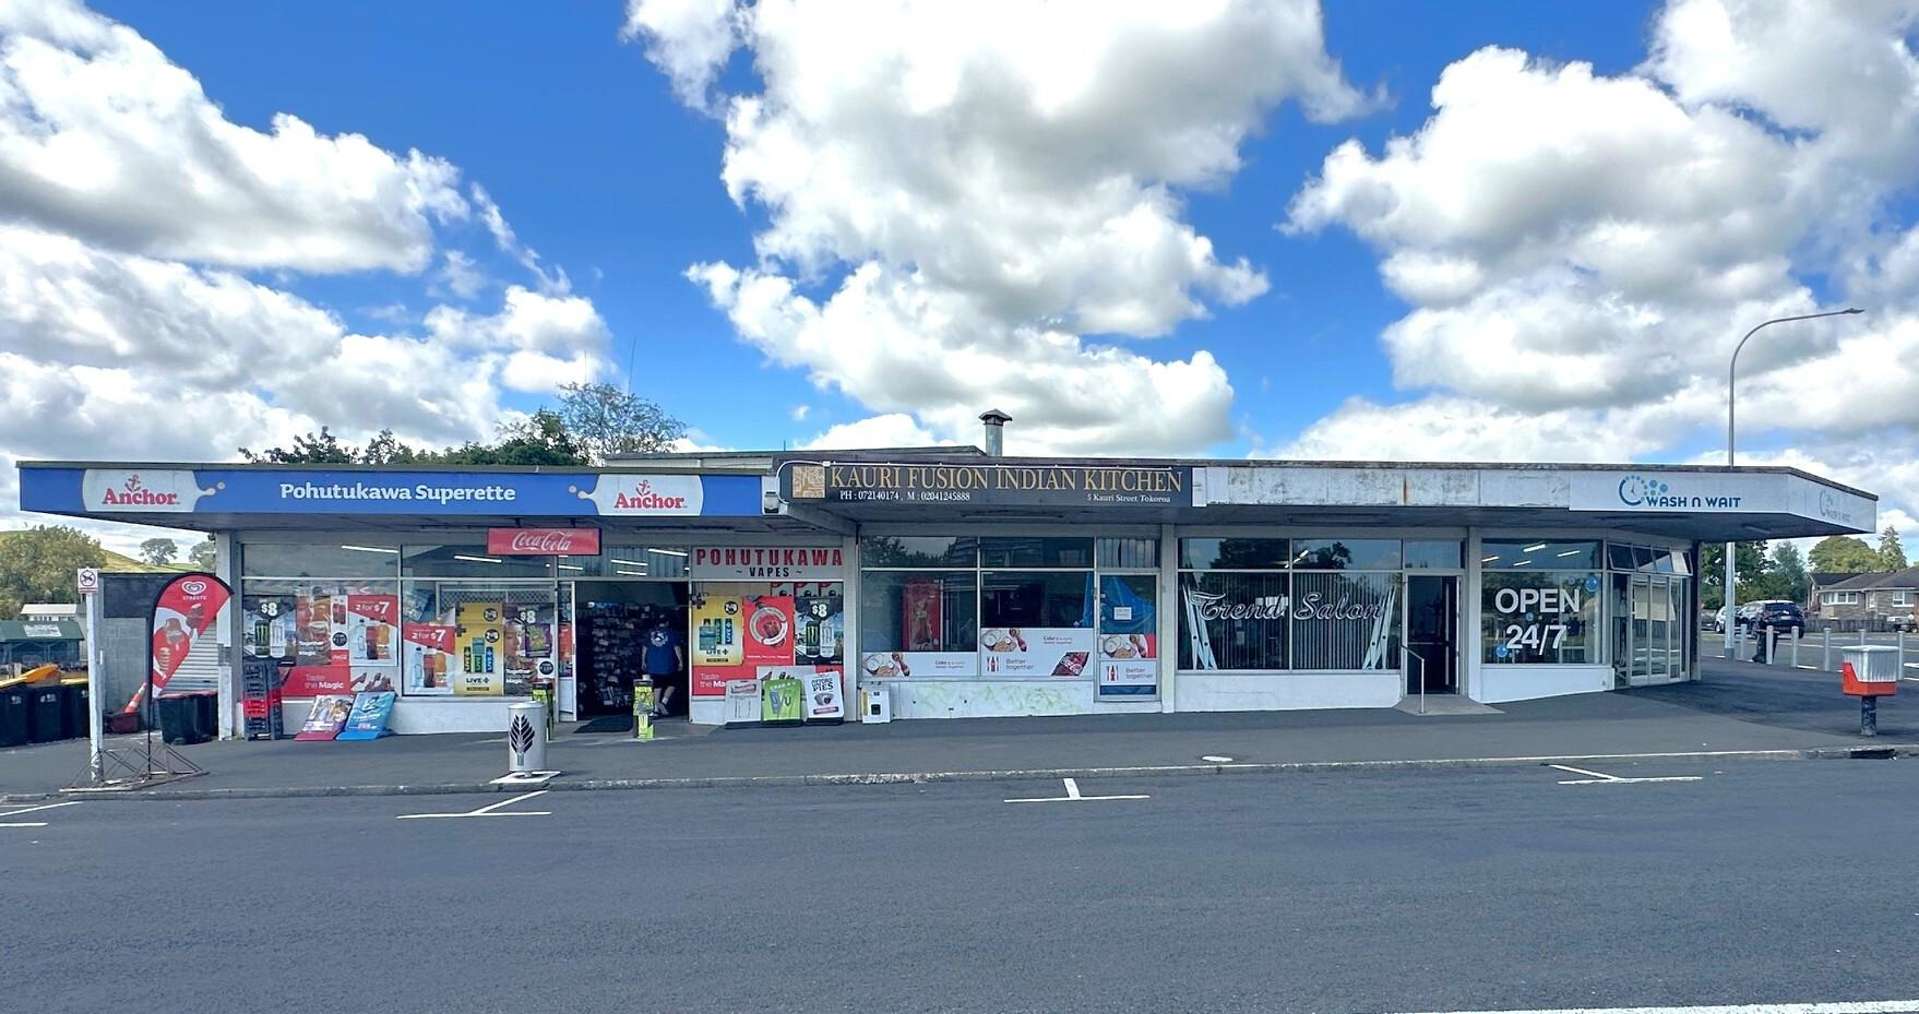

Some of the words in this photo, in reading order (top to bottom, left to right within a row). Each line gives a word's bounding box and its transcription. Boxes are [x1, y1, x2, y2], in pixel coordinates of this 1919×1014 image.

[831, 466, 900, 488] KAURI
[908, 467, 989, 489] FUSION
[996, 468, 1076, 490] INDIAN
[1083, 469, 1183, 492] KITCHEN
[102, 487, 178, 505] Anchor
[280, 482, 411, 500] Pohutukawa
[415, 484, 516, 505] Superette
[614, 492, 685, 509] Anchor
[840, 490, 852, 500] PH
[858, 490, 899, 500] 072140174
[1116, 494, 1138, 502] Street
[1645, 496, 1688, 508] WASH
[1705, 496, 1742, 508] WAIT
[512, 531, 573, 551] Coca-Cola
[696, 548, 843, 566] POHUTUKAWA
[749, 567, 790, 577] VAPES
[374, 601, 390, 614] $7
[1190, 591, 1286, 620] Trend
[1293, 592, 1382, 620] Salon
[1495, 588, 1580, 613] OPEN
[261, 602, 278, 616] $8
[812, 604, 827, 618] $8
[430, 629, 446, 642] $7
[1506, 624, 1567, 656] 24/7
[319, 681, 344, 690] Magic
